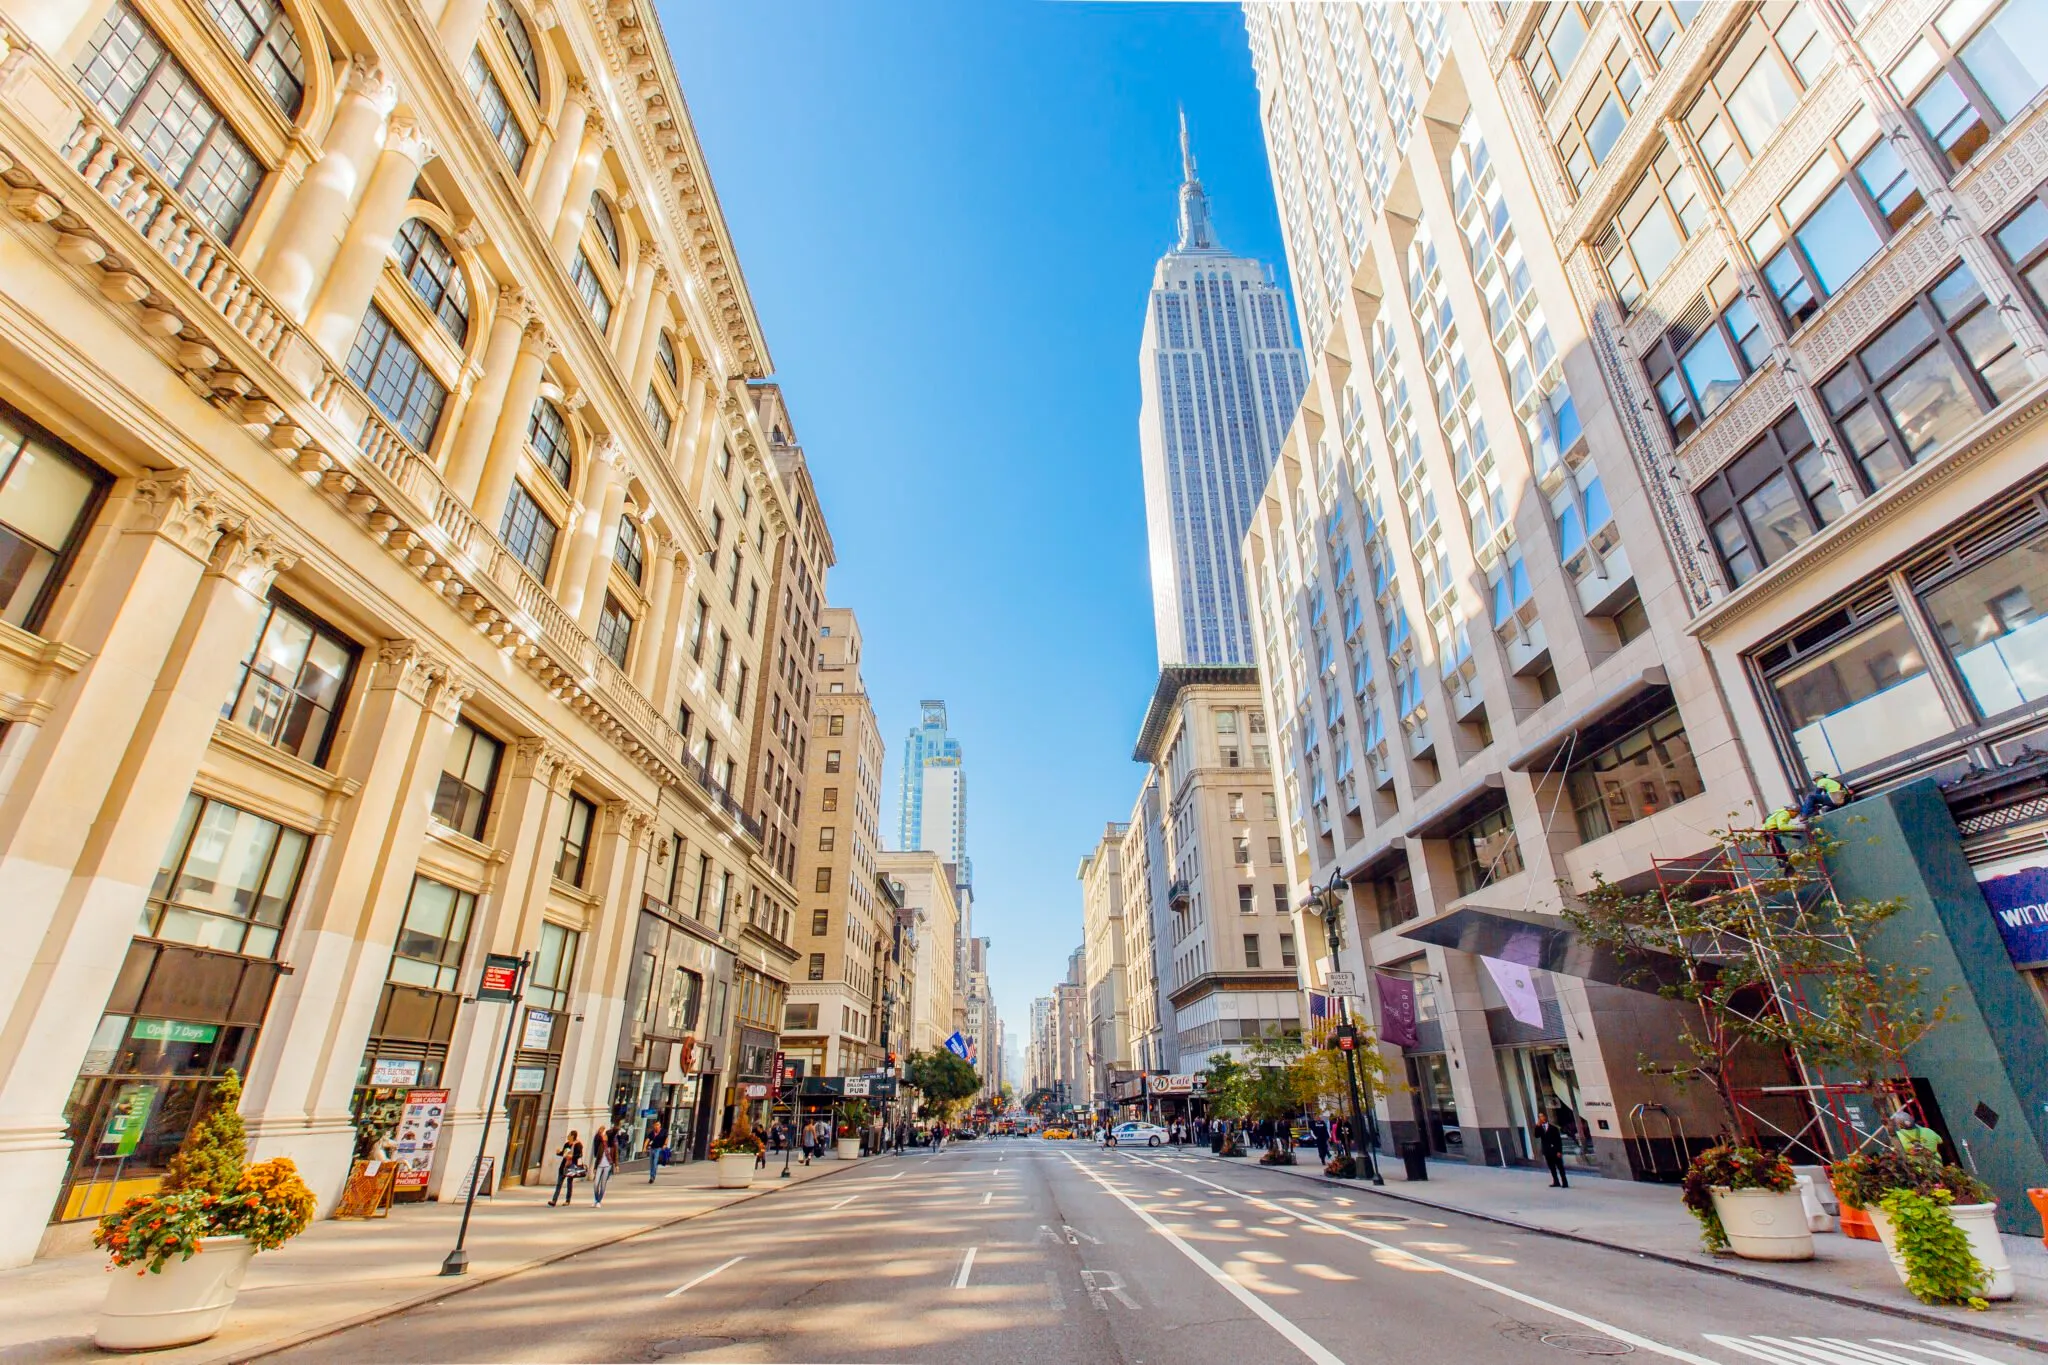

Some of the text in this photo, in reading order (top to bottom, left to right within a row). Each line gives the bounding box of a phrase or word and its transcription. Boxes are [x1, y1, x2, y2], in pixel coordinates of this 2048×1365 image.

[146, 1023, 205, 1039] Open 7 Days
